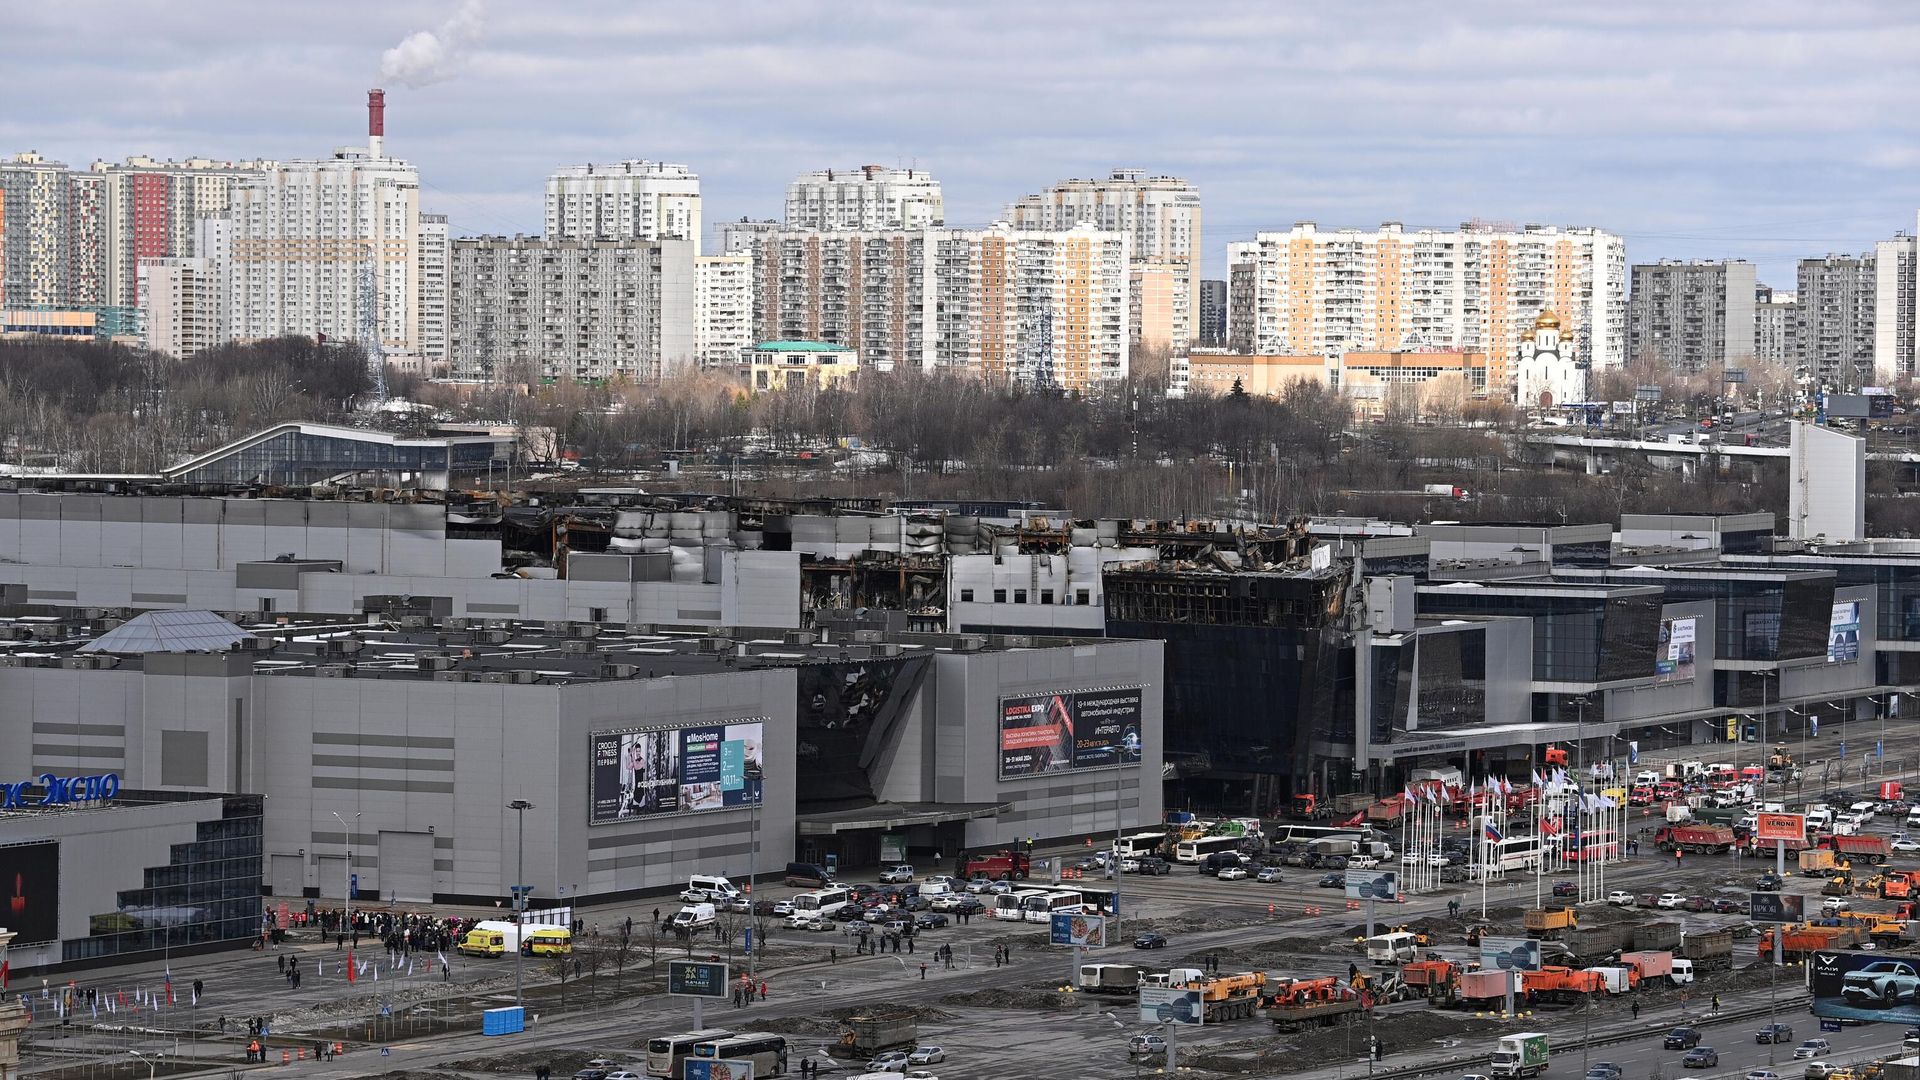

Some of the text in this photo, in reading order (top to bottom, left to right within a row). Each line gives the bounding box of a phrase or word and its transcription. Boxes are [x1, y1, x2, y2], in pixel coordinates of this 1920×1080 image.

[1006, 704, 1045, 715] LOGISTIKA EXPO
[597, 741, 617, 750] CROCUS
[597, 749, 617, 757] FITNESS
[597, 758, 617, 766] ПЕРВЫЙ
[722, 761, 727, 771] 2
[722, 774, 736, 786] 10,11
